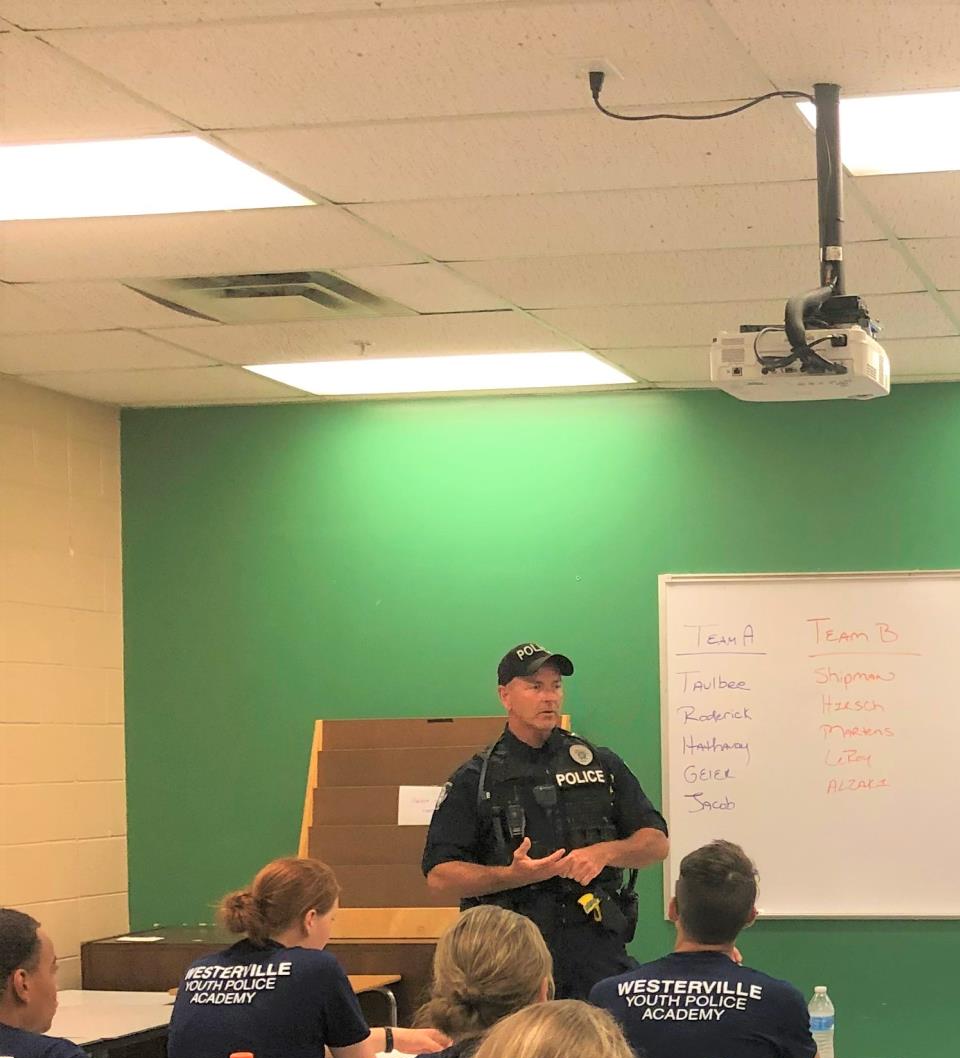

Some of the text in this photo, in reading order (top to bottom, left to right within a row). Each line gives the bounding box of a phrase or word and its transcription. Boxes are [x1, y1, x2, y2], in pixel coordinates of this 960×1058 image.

[743, 624, 754, 647] A
[875, 622, 898, 643] B
[677, 705, 752, 725] Roderick
[555, 770, 606, 787] POLICE
[184, 962, 292, 981] WESTERVILLE
[184, 977, 277, 992] YOUTH POLICE
[617, 979, 763, 1000] WESTERVILLE
[190, 992, 257, 1004] ACADEMY
[625, 994, 748, 1010] YOUTH POLICE
[641, 1008, 726, 1021] ACADEMY
